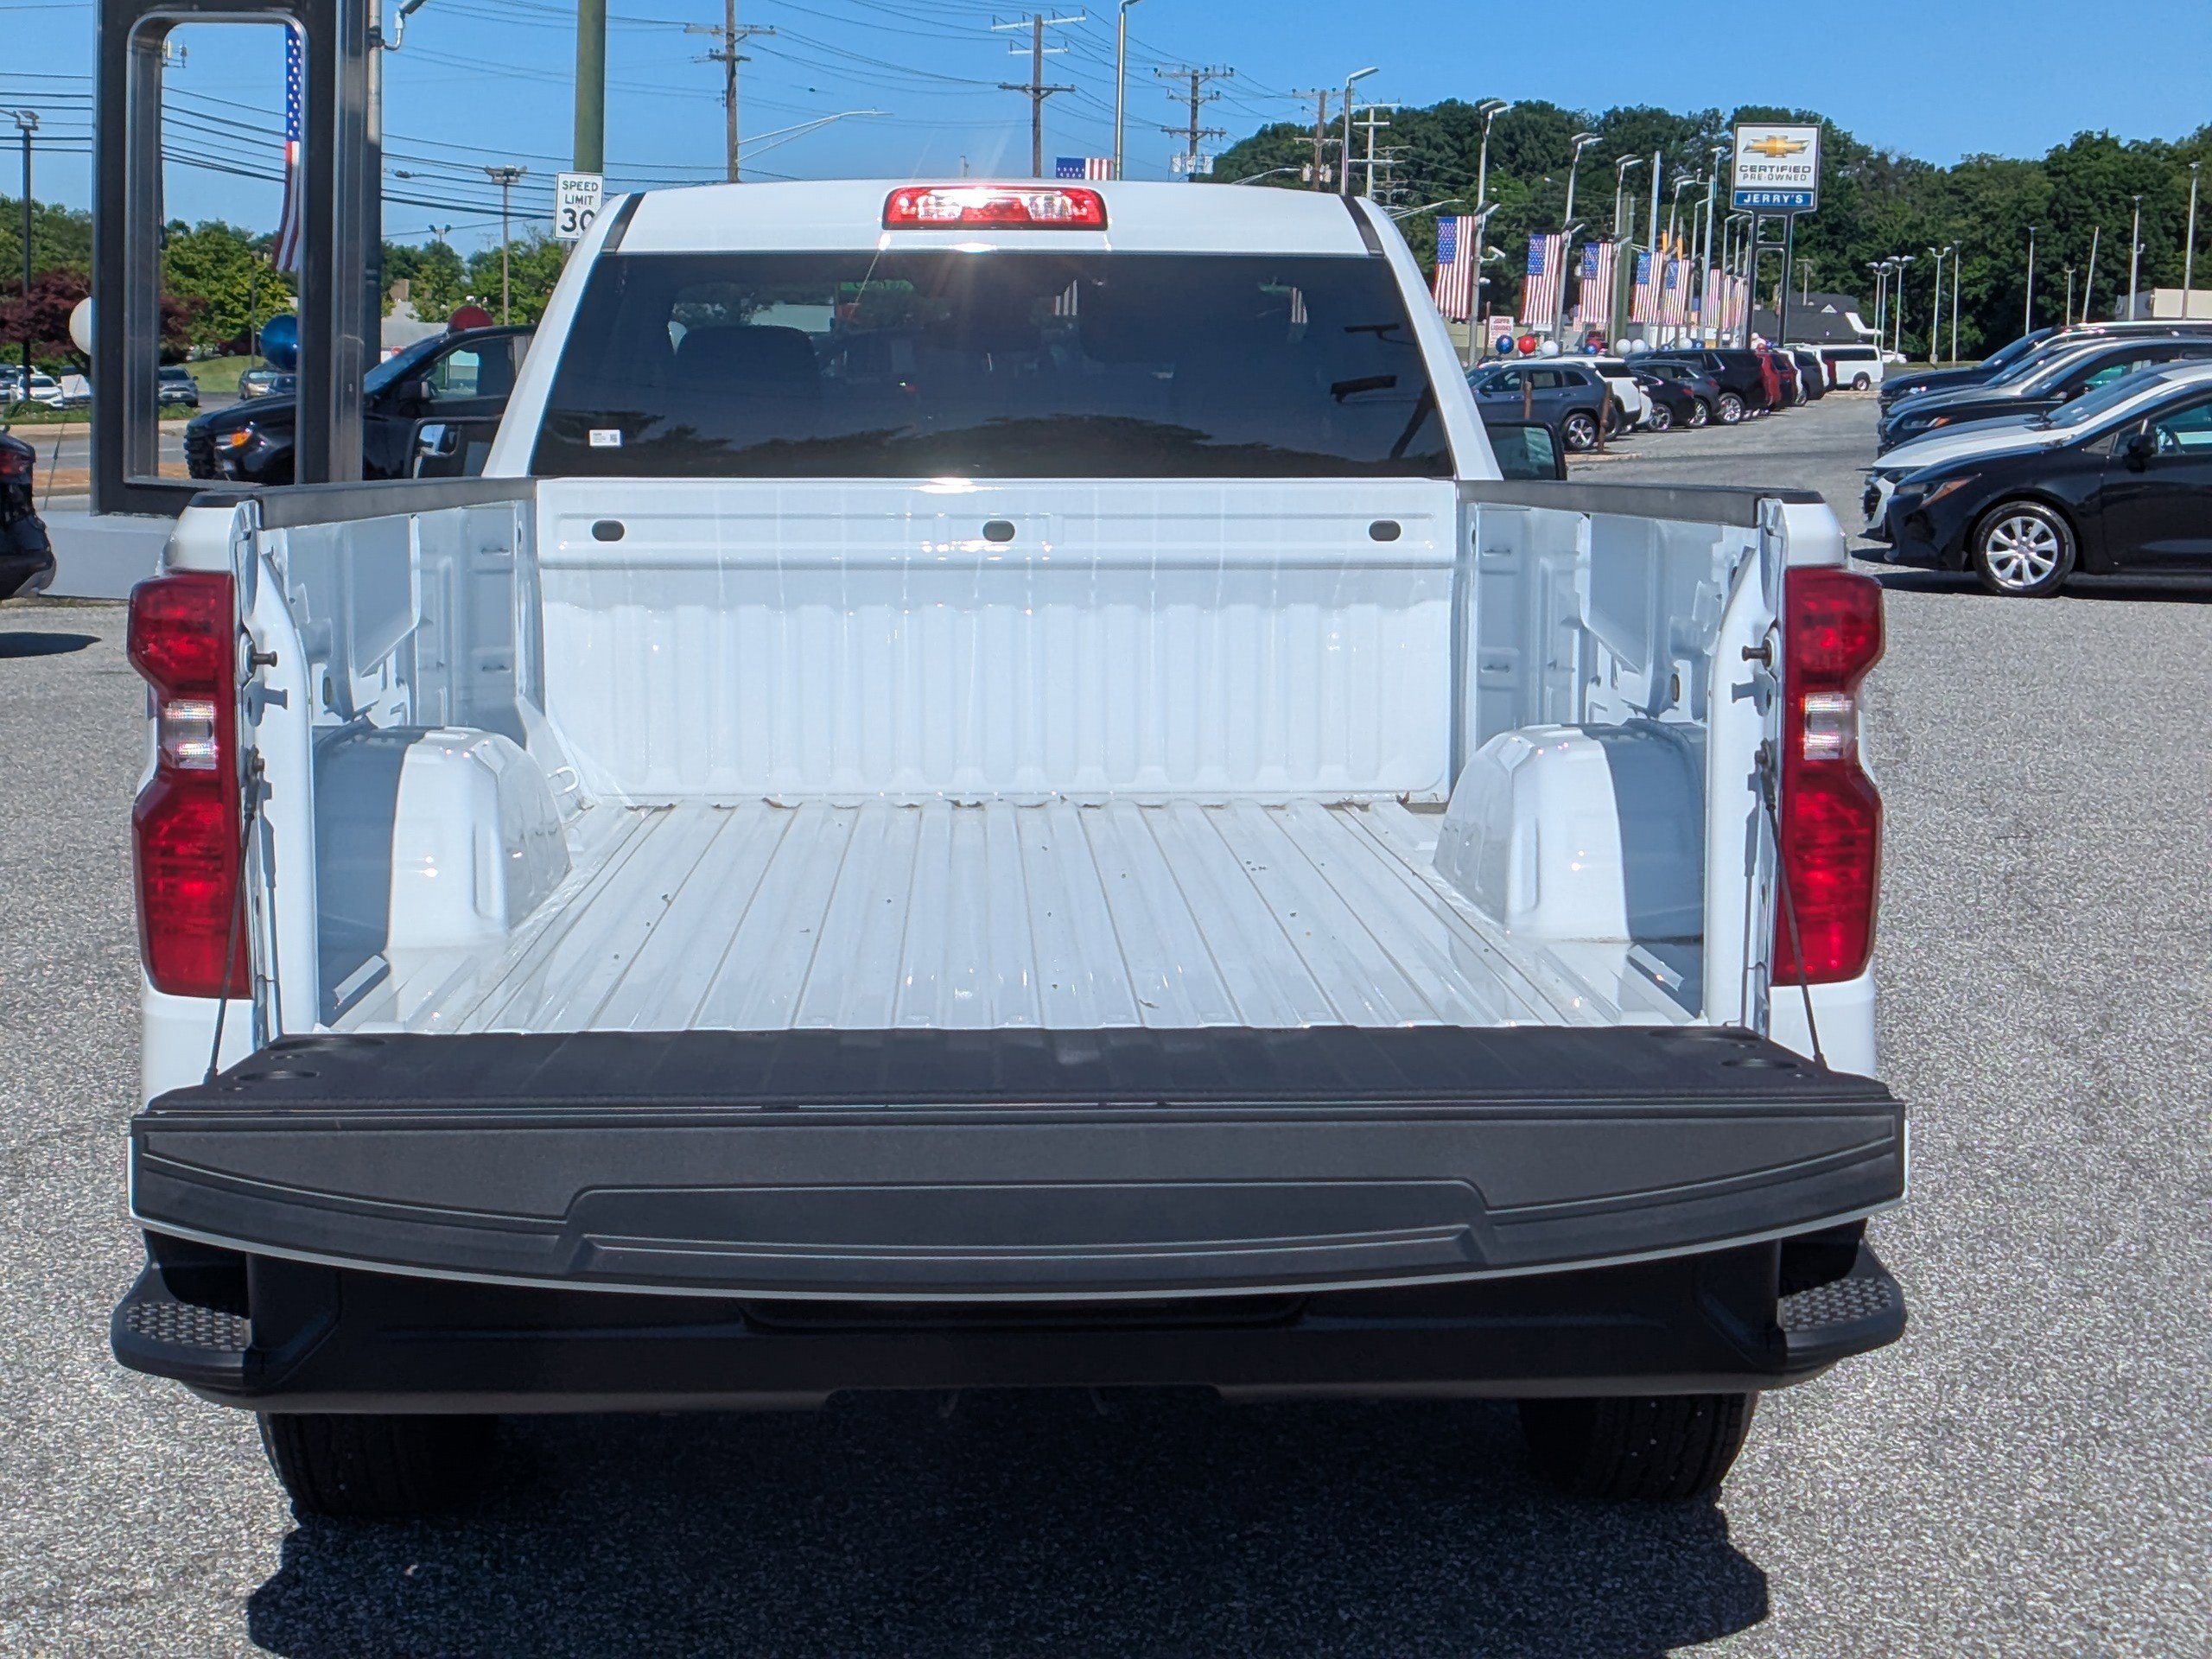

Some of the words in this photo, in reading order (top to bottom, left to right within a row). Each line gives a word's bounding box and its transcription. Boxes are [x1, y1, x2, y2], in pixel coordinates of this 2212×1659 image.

[1739, 165, 1811, 174] CERTIFIED
[562, 180, 599, 192] SPEED
[564, 194, 594, 206] LIMIT
[1744, 193, 1804, 204] JERRY'S
[560, 207, 595, 232] 30
